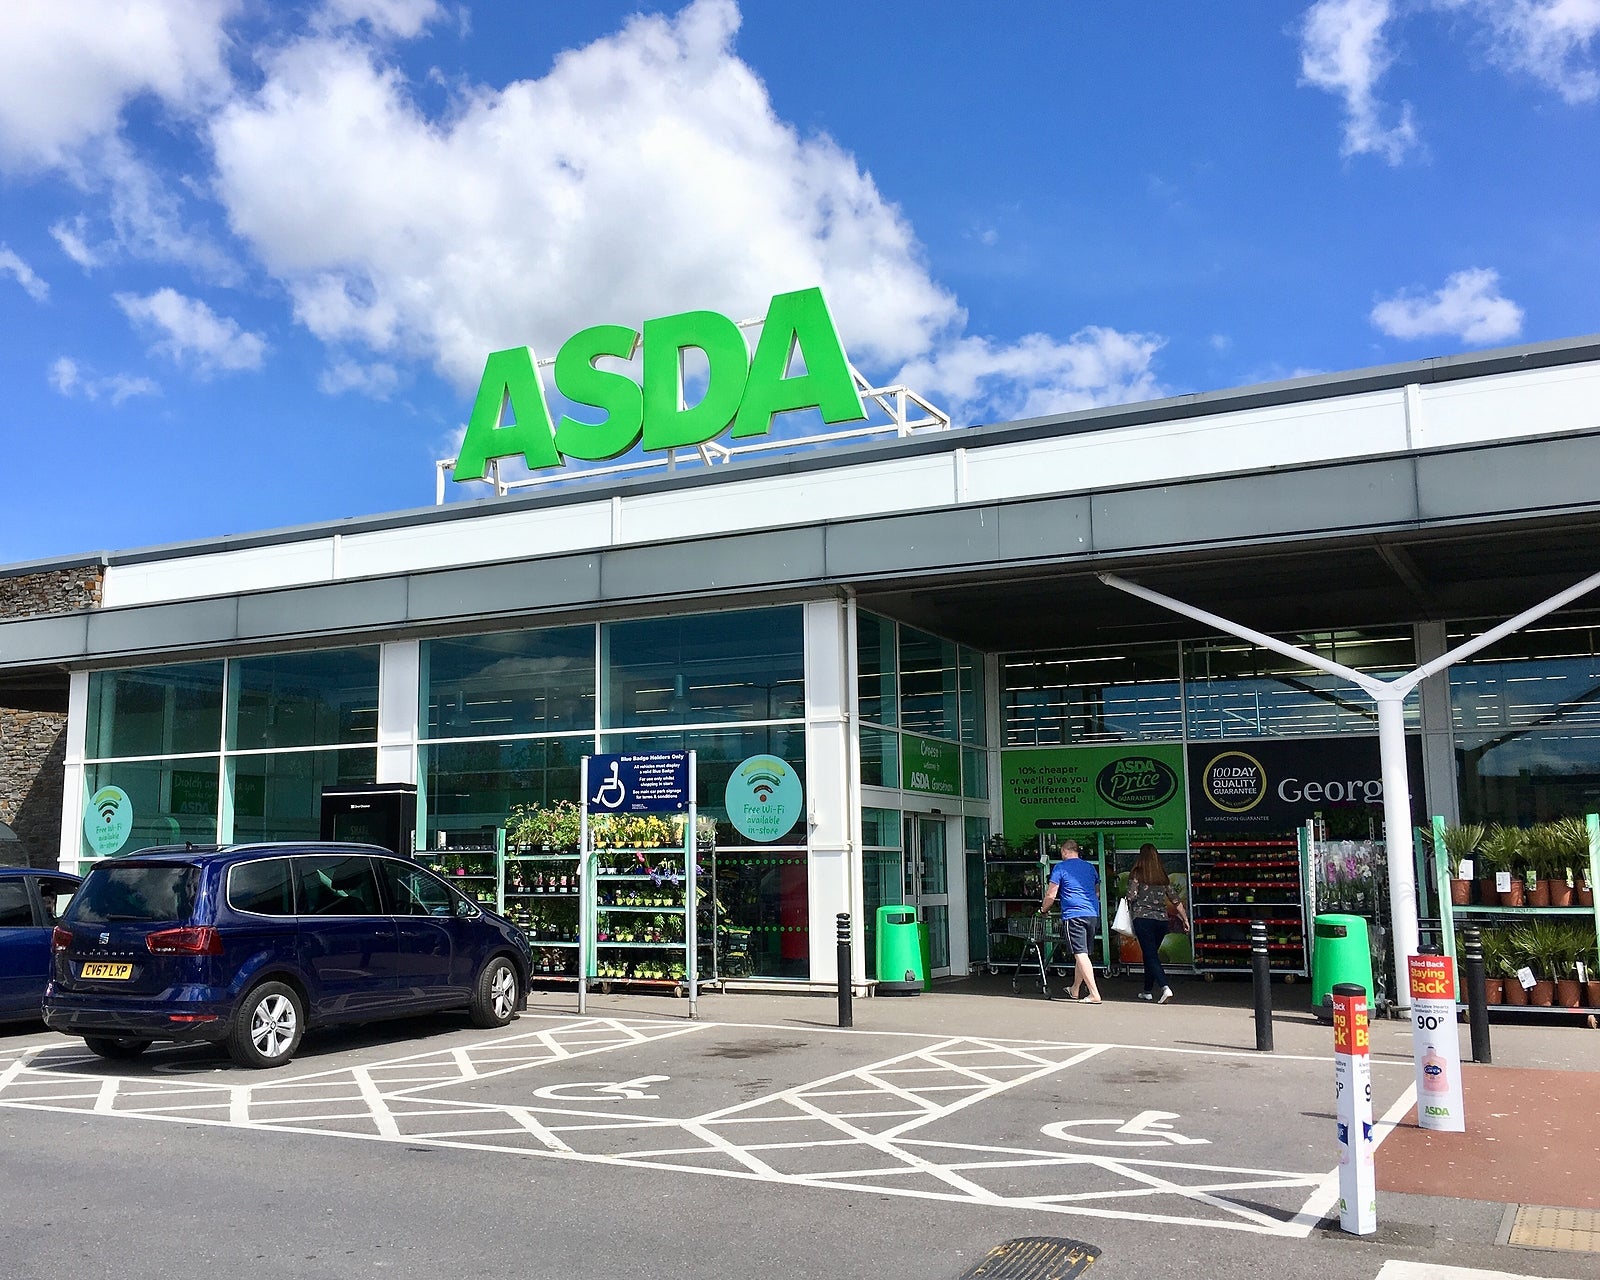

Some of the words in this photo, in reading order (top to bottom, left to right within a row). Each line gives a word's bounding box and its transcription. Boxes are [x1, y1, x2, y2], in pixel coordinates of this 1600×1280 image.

[452, 286, 868, 482] ASDA
[1018, 767, 1036, 775] 10%
[1039, 766, 1078, 776] cheaper
[1115, 760, 1156, 774] ASDA
[1213, 768, 1230, 777] 100
[1232, 767, 1256, 776] DAY
[911, 772, 930, 789] ASDA
[1022, 776, 1044, 784] we'll
[1046, 776, 1067, 786] give
[1070, 776, 1088, 785] you
[1110, 773, 1160, 798] Price
[1213, 780, 1256, 788] QUALITY
[1032, 786, 1084, 794] difference.
[1278, 778, 1384, 804] Georg
[1020, 796, 1079, 805] Guaranteed.
[181, 801, 210, 813] ASDA
[744, 804, 760, 814] Free
[762, 804, 784, 814] Wi-Fi
[747, 816, 780, 824] available
[96, 826, 106, 834] Free
[748, 826, 778, 835] in-store
[86, 964, 108, 977] CV67
[109, 965, 128, 977] LXP
[1425, 1106, 1449, 1116] ASDA
